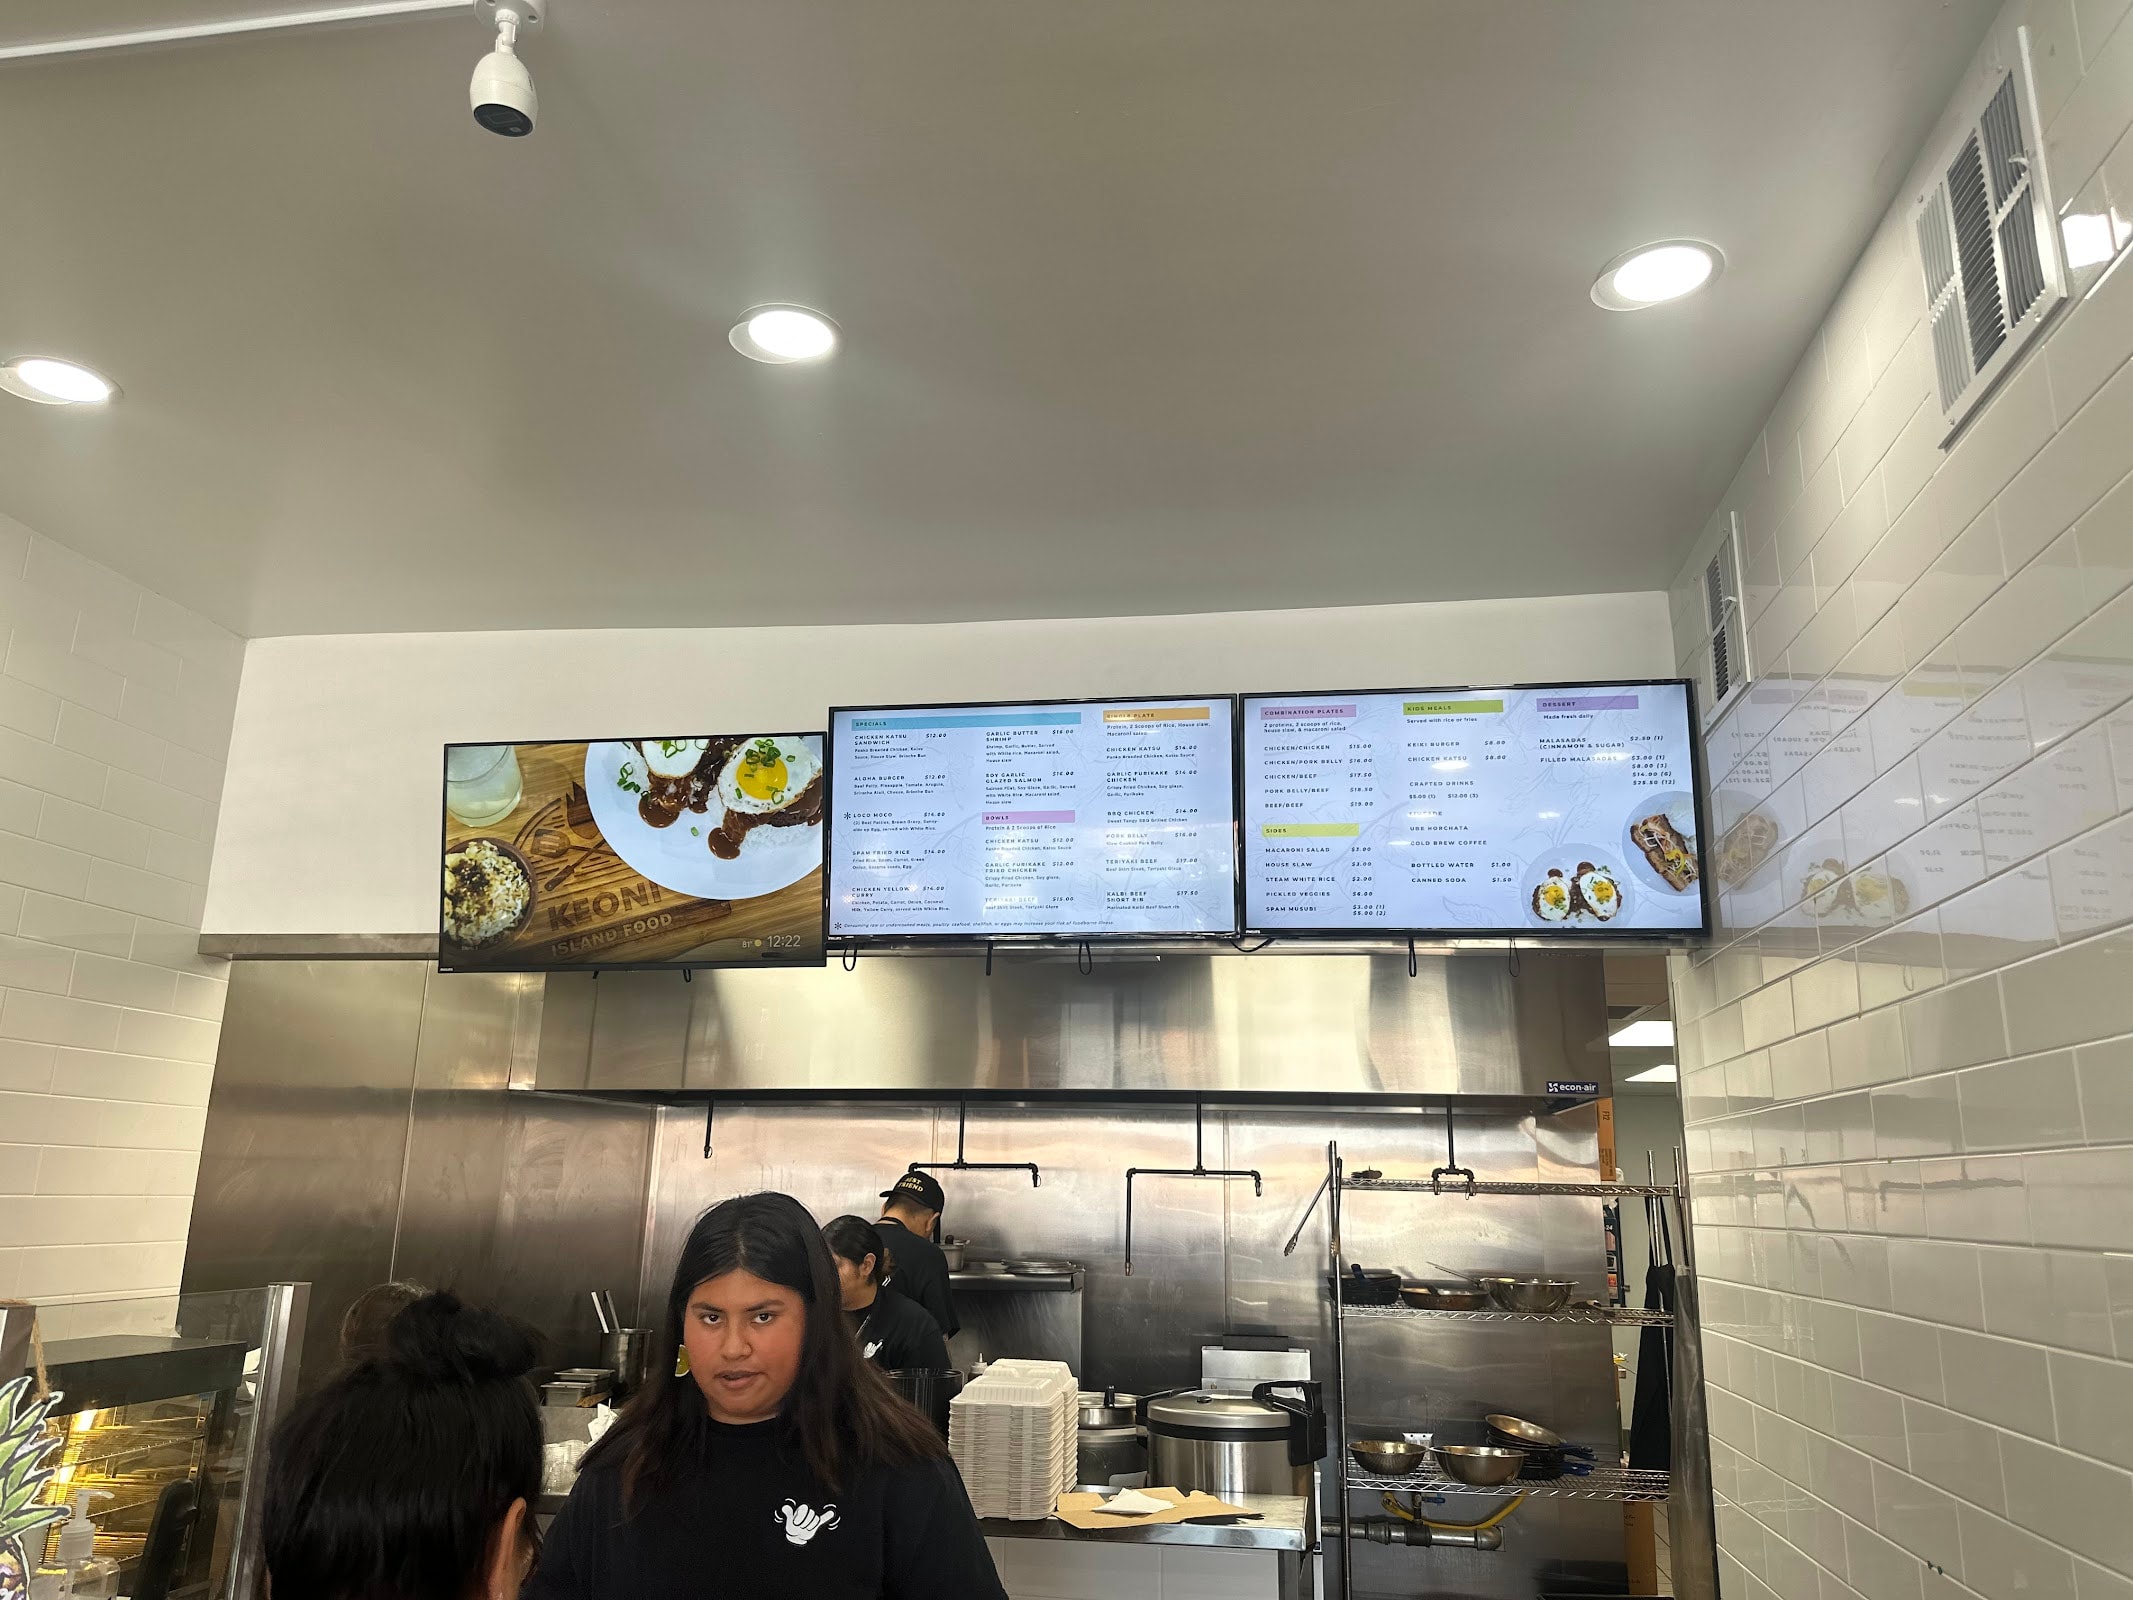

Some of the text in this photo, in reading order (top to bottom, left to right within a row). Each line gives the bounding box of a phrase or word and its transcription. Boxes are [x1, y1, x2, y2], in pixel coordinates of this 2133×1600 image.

[548, 881, 662, 932] KEONI
[551, 913, 673, 957] ISLAND FOOD
[767, 934, 801, 948] 12:22
